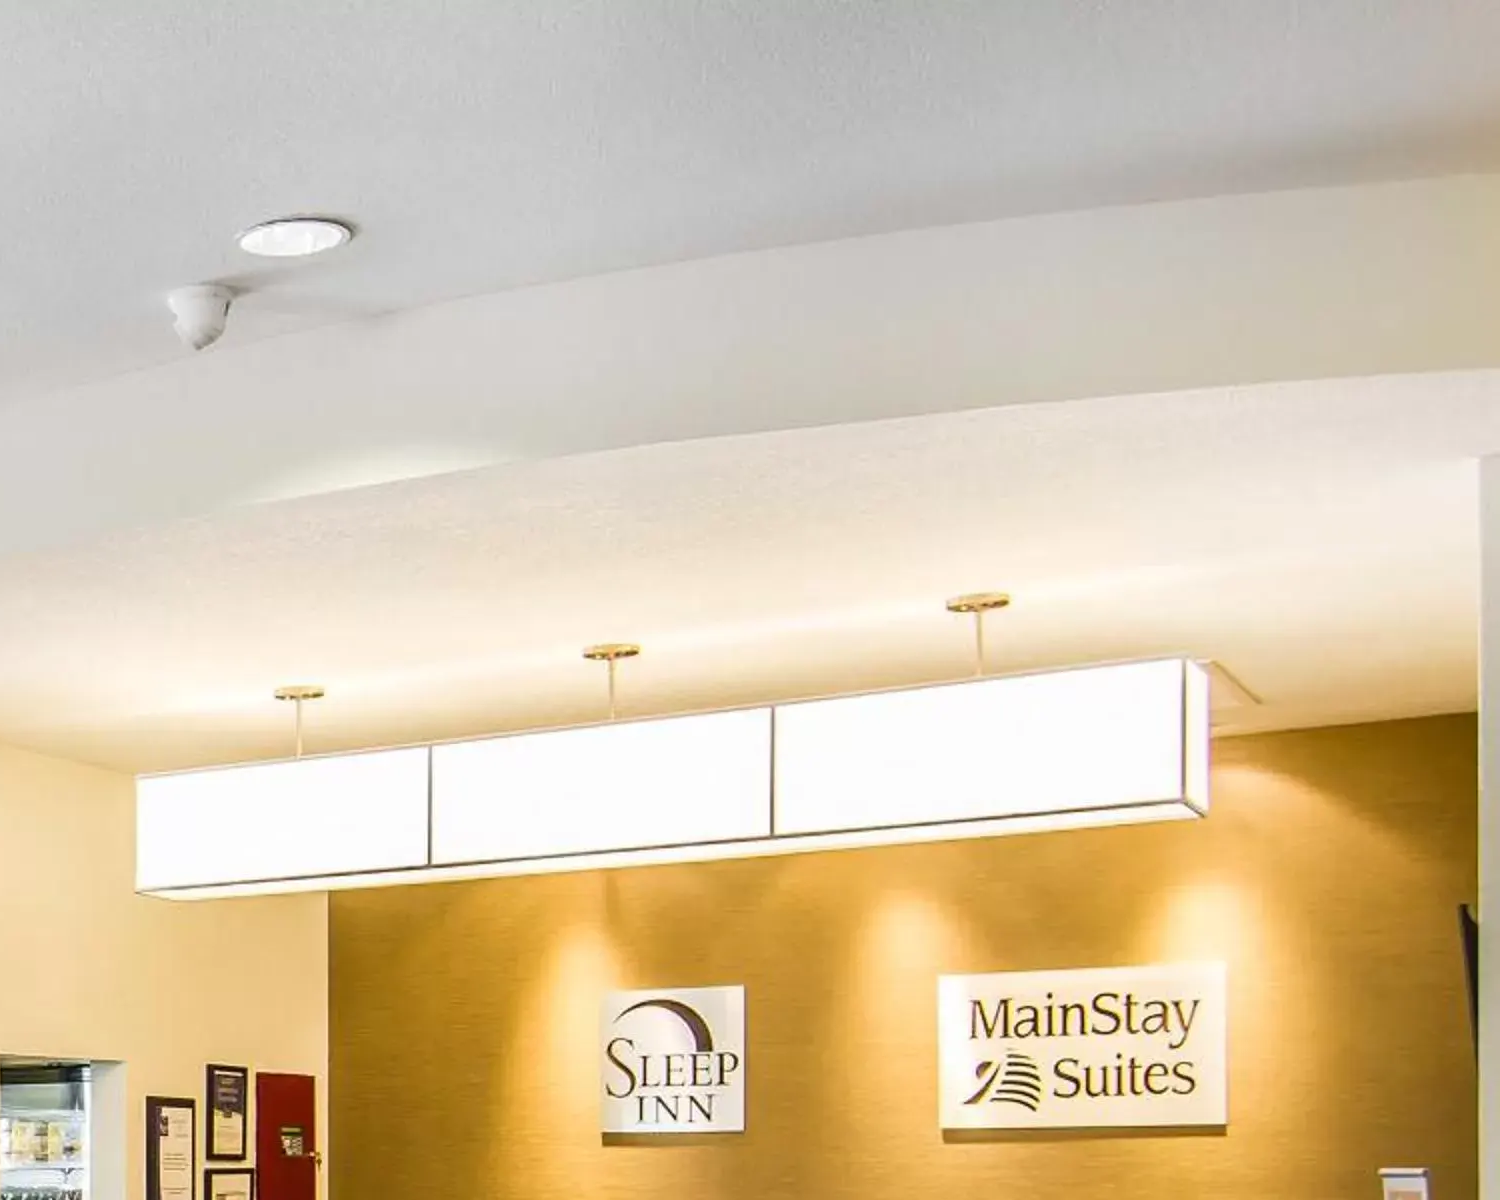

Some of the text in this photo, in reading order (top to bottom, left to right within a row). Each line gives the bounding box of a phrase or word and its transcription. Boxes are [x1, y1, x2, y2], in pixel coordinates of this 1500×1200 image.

[969, 991, 1201, 1050] MainStay
[605, 1037, 739, 1099] SLEEP
[1052, 1053, 1197, 1099] Suites
[635, 1093, 718, 1124] INN
